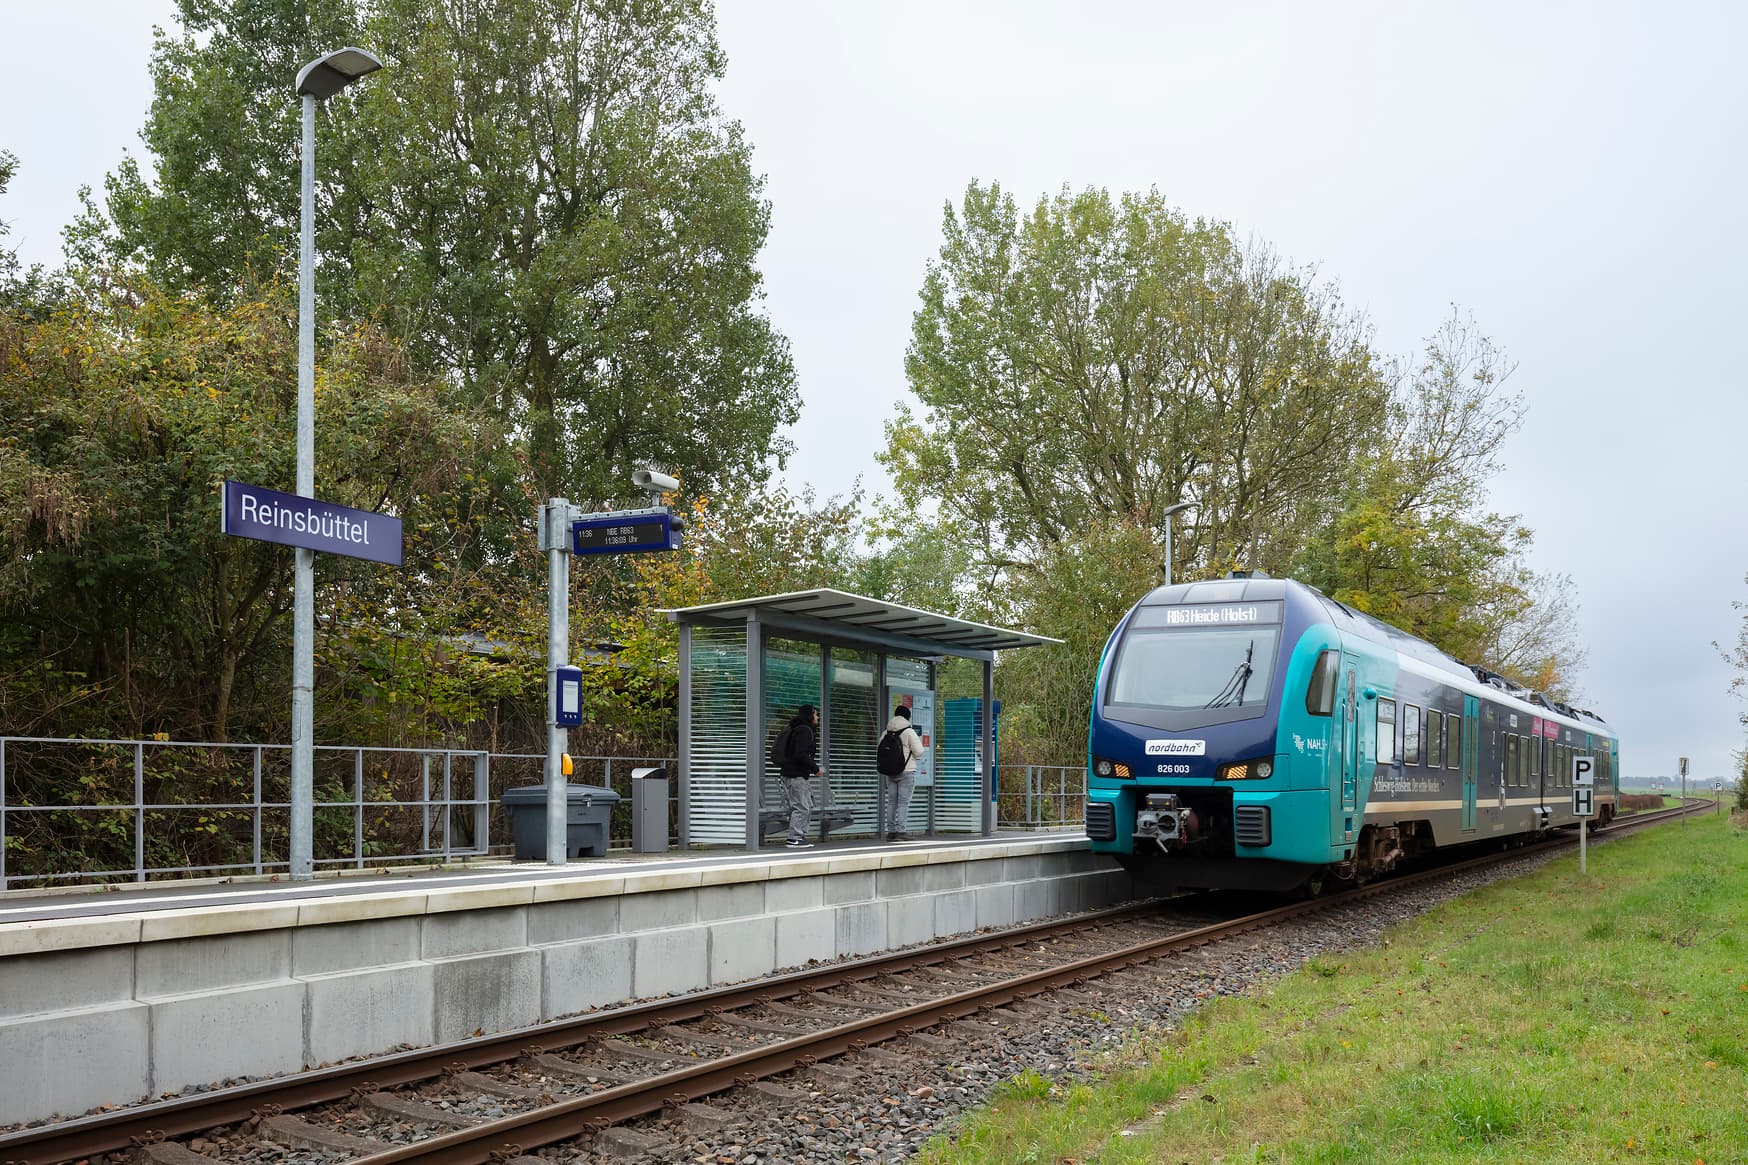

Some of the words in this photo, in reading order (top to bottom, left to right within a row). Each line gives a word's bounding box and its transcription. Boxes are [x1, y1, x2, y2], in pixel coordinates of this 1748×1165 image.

[241, 494, 370, 545] Reinsbüttel
[1167, 609, 1190, 624] RB63
[1190, 608, 1220, 623] Heide
[1221, 607, 1257, 622] (Holst)
[1149, 743, 1196, 752] nordbahn
[1157, 764, 1173, 773] 826
[1174, 764, 1190, 773] 003
[1576, 760, 1591, 781] P
[1576, 790, 1591, 813] H
